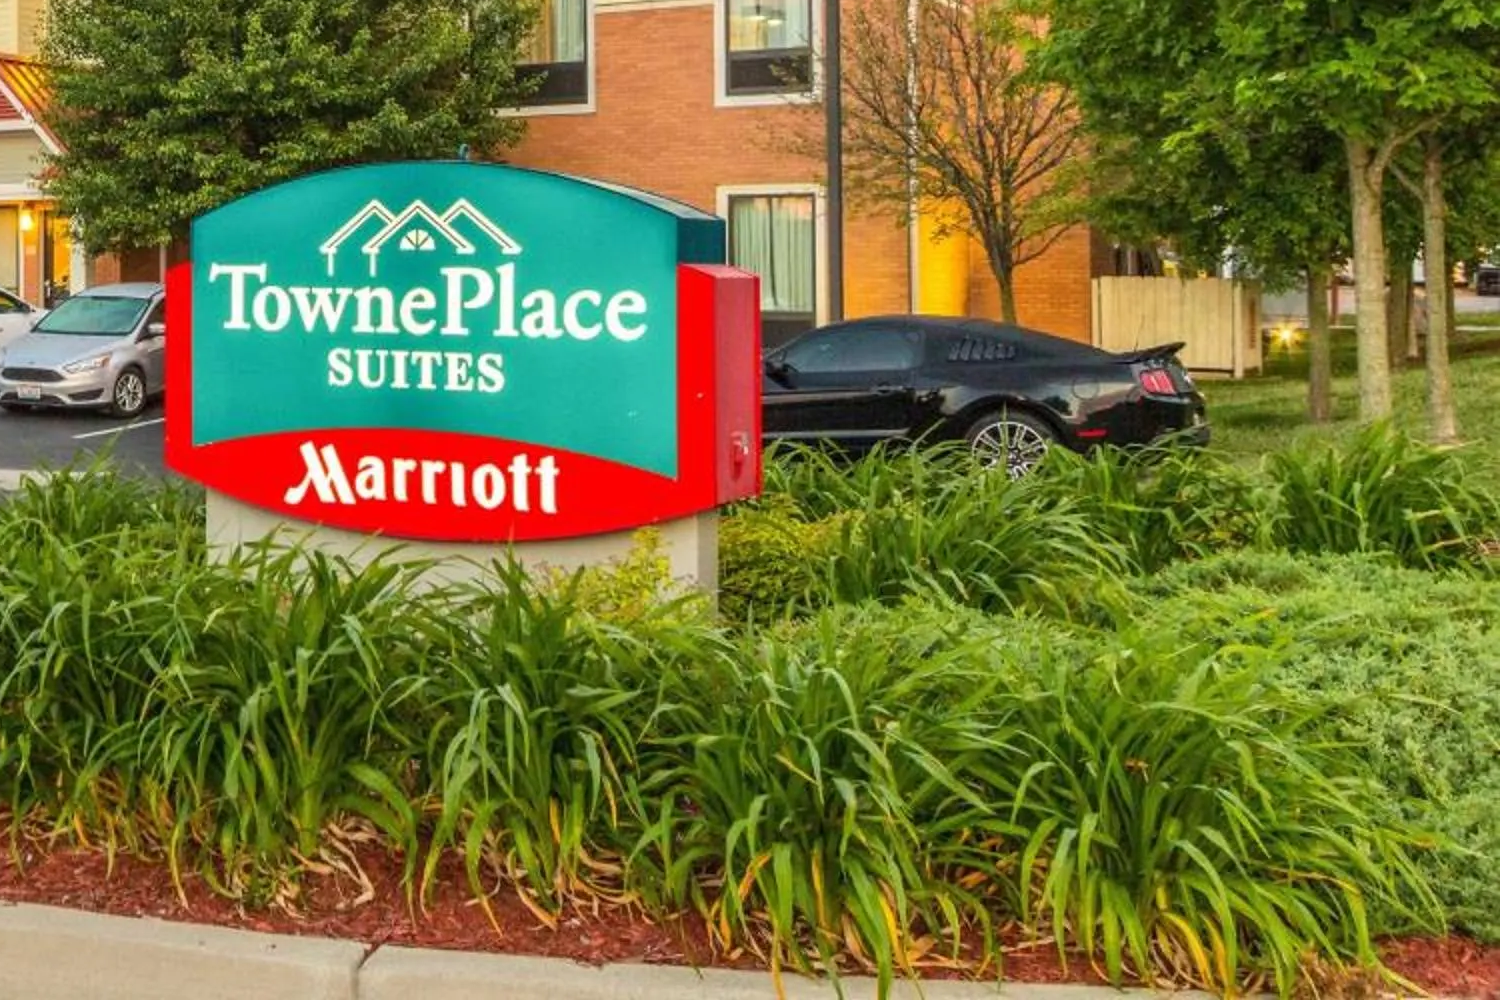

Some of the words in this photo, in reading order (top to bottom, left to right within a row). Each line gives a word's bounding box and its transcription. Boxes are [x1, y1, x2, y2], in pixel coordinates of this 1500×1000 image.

[209, 262, 647, 342] TownePlace
[327, 347, 505, 393] SUITES
[285, 441, 559, 513] Marriott
